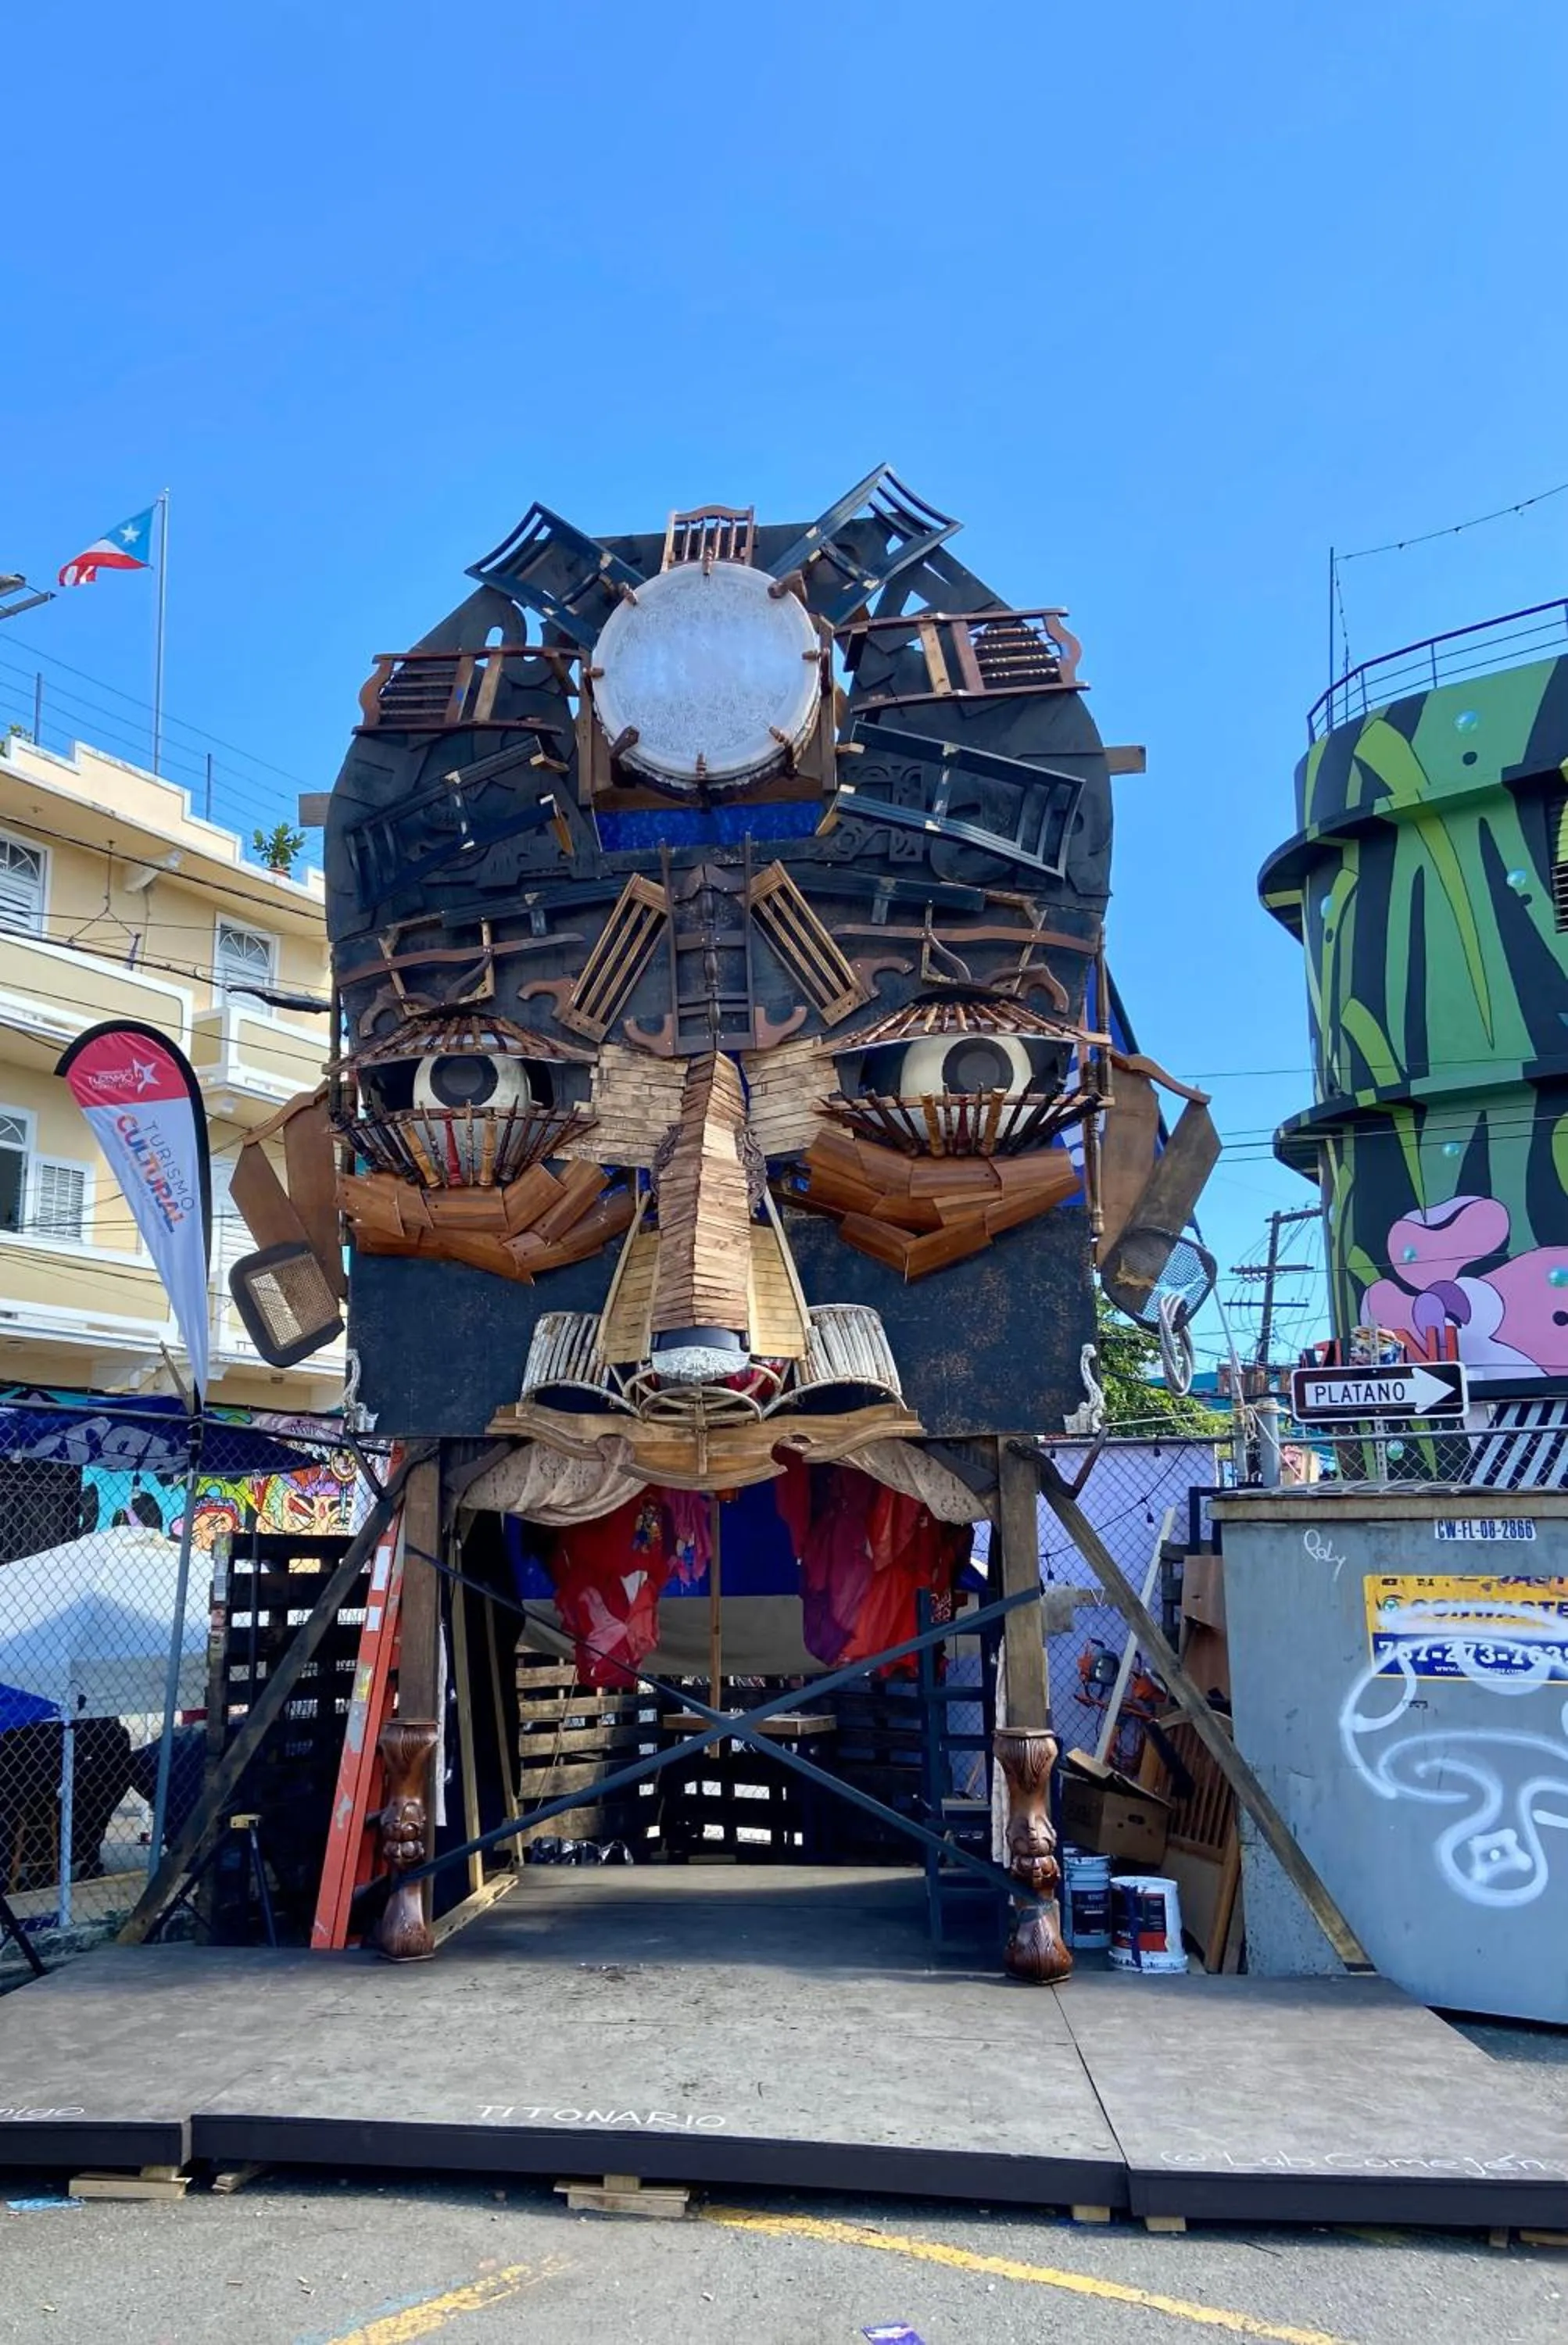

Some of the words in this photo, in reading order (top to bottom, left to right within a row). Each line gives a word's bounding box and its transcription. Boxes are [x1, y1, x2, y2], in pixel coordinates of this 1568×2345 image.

[116, 1115, 184, 1233] CULTURAL
[143, 1119, 195, 1211] TURISMO
[1315, 1381, 1405, 1404] PLATANO
[475, 2105, 725, 2128] TITONARIO
